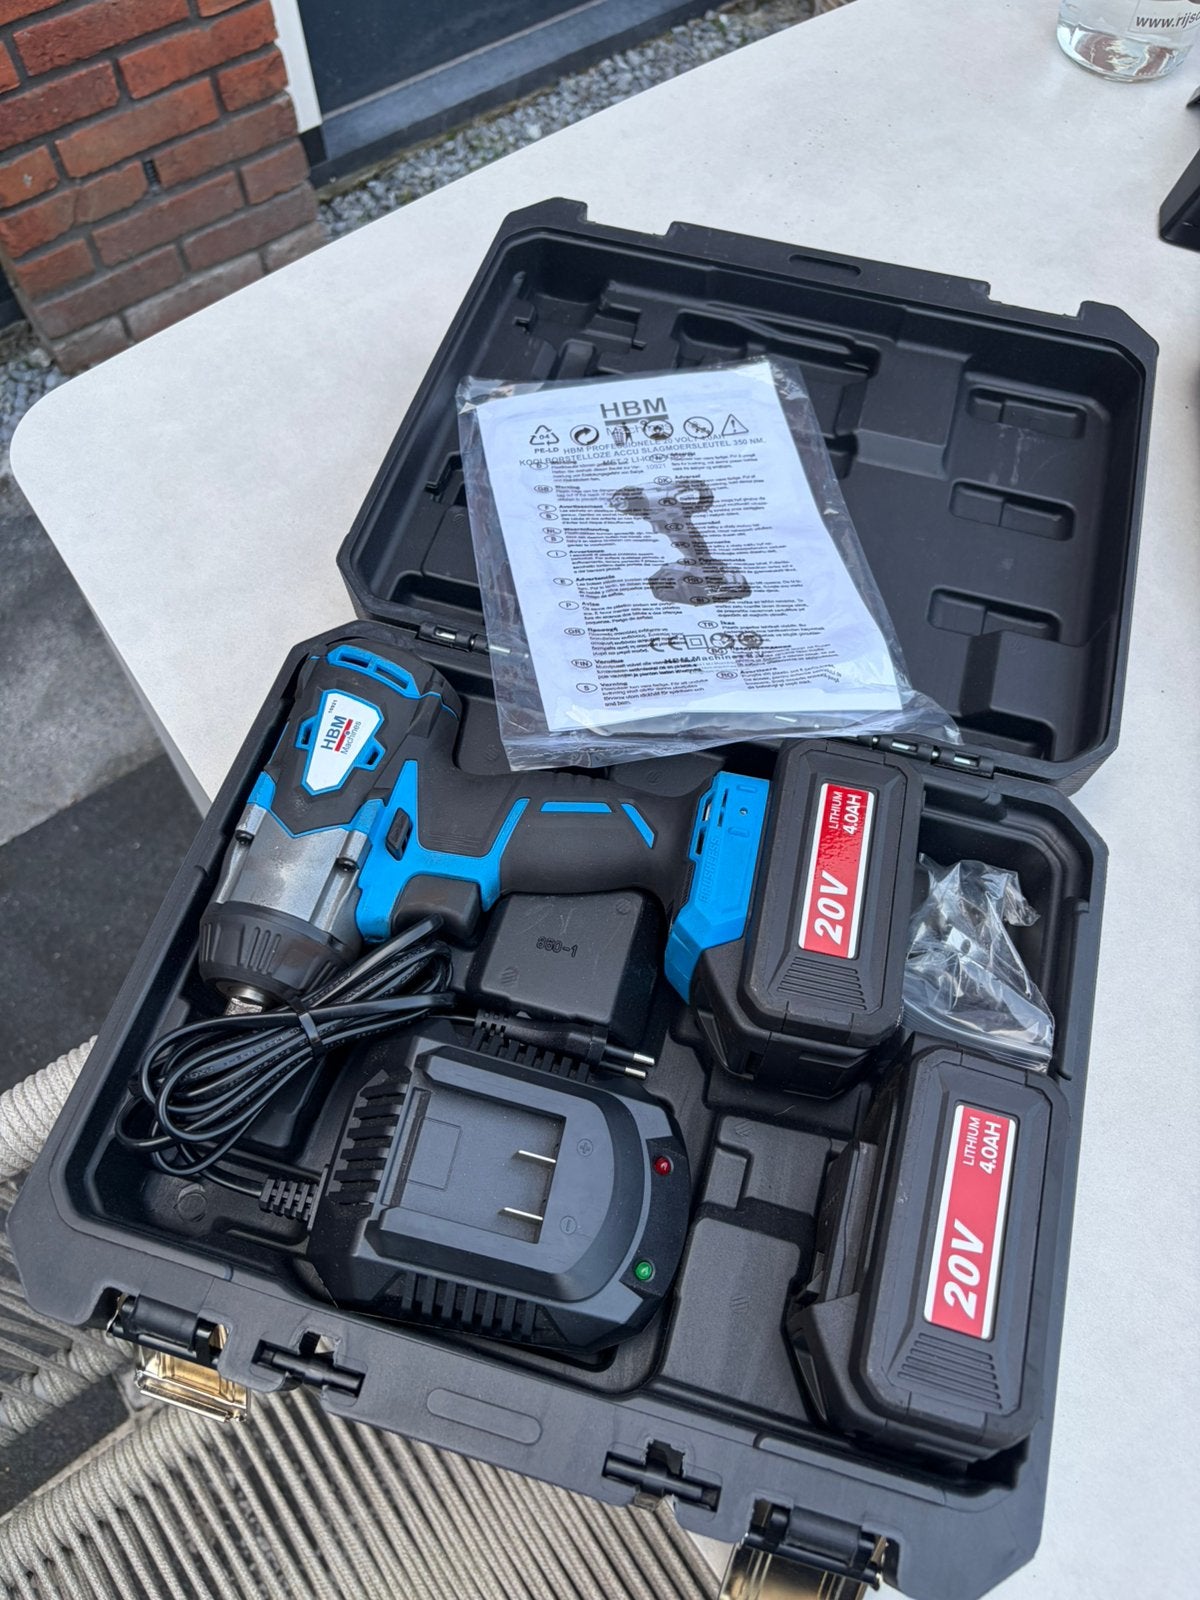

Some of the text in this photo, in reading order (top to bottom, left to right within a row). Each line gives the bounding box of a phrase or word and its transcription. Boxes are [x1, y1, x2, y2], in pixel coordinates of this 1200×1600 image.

[600, 397, 667, 419] HBM
[563, 446, 586, 454] HBM
[613, 449, 639, 457] ACCU
[641, 440, 731, 454] SLAGMOERSLEUTEL
[320, 715, 347, 750] HBM
[340, 721, 362, 755] Machines
[829, 791, 843, 830] LITHIUM
[843, 793, 862, 835] 4.0AH
[814, 869, 849, 945] 20V
[963, 1116, 982, 1166] LITHIUM
[979, 1121, 1003, 1175] 4.0AH
[943, 1218, 985, 1320] 20V
